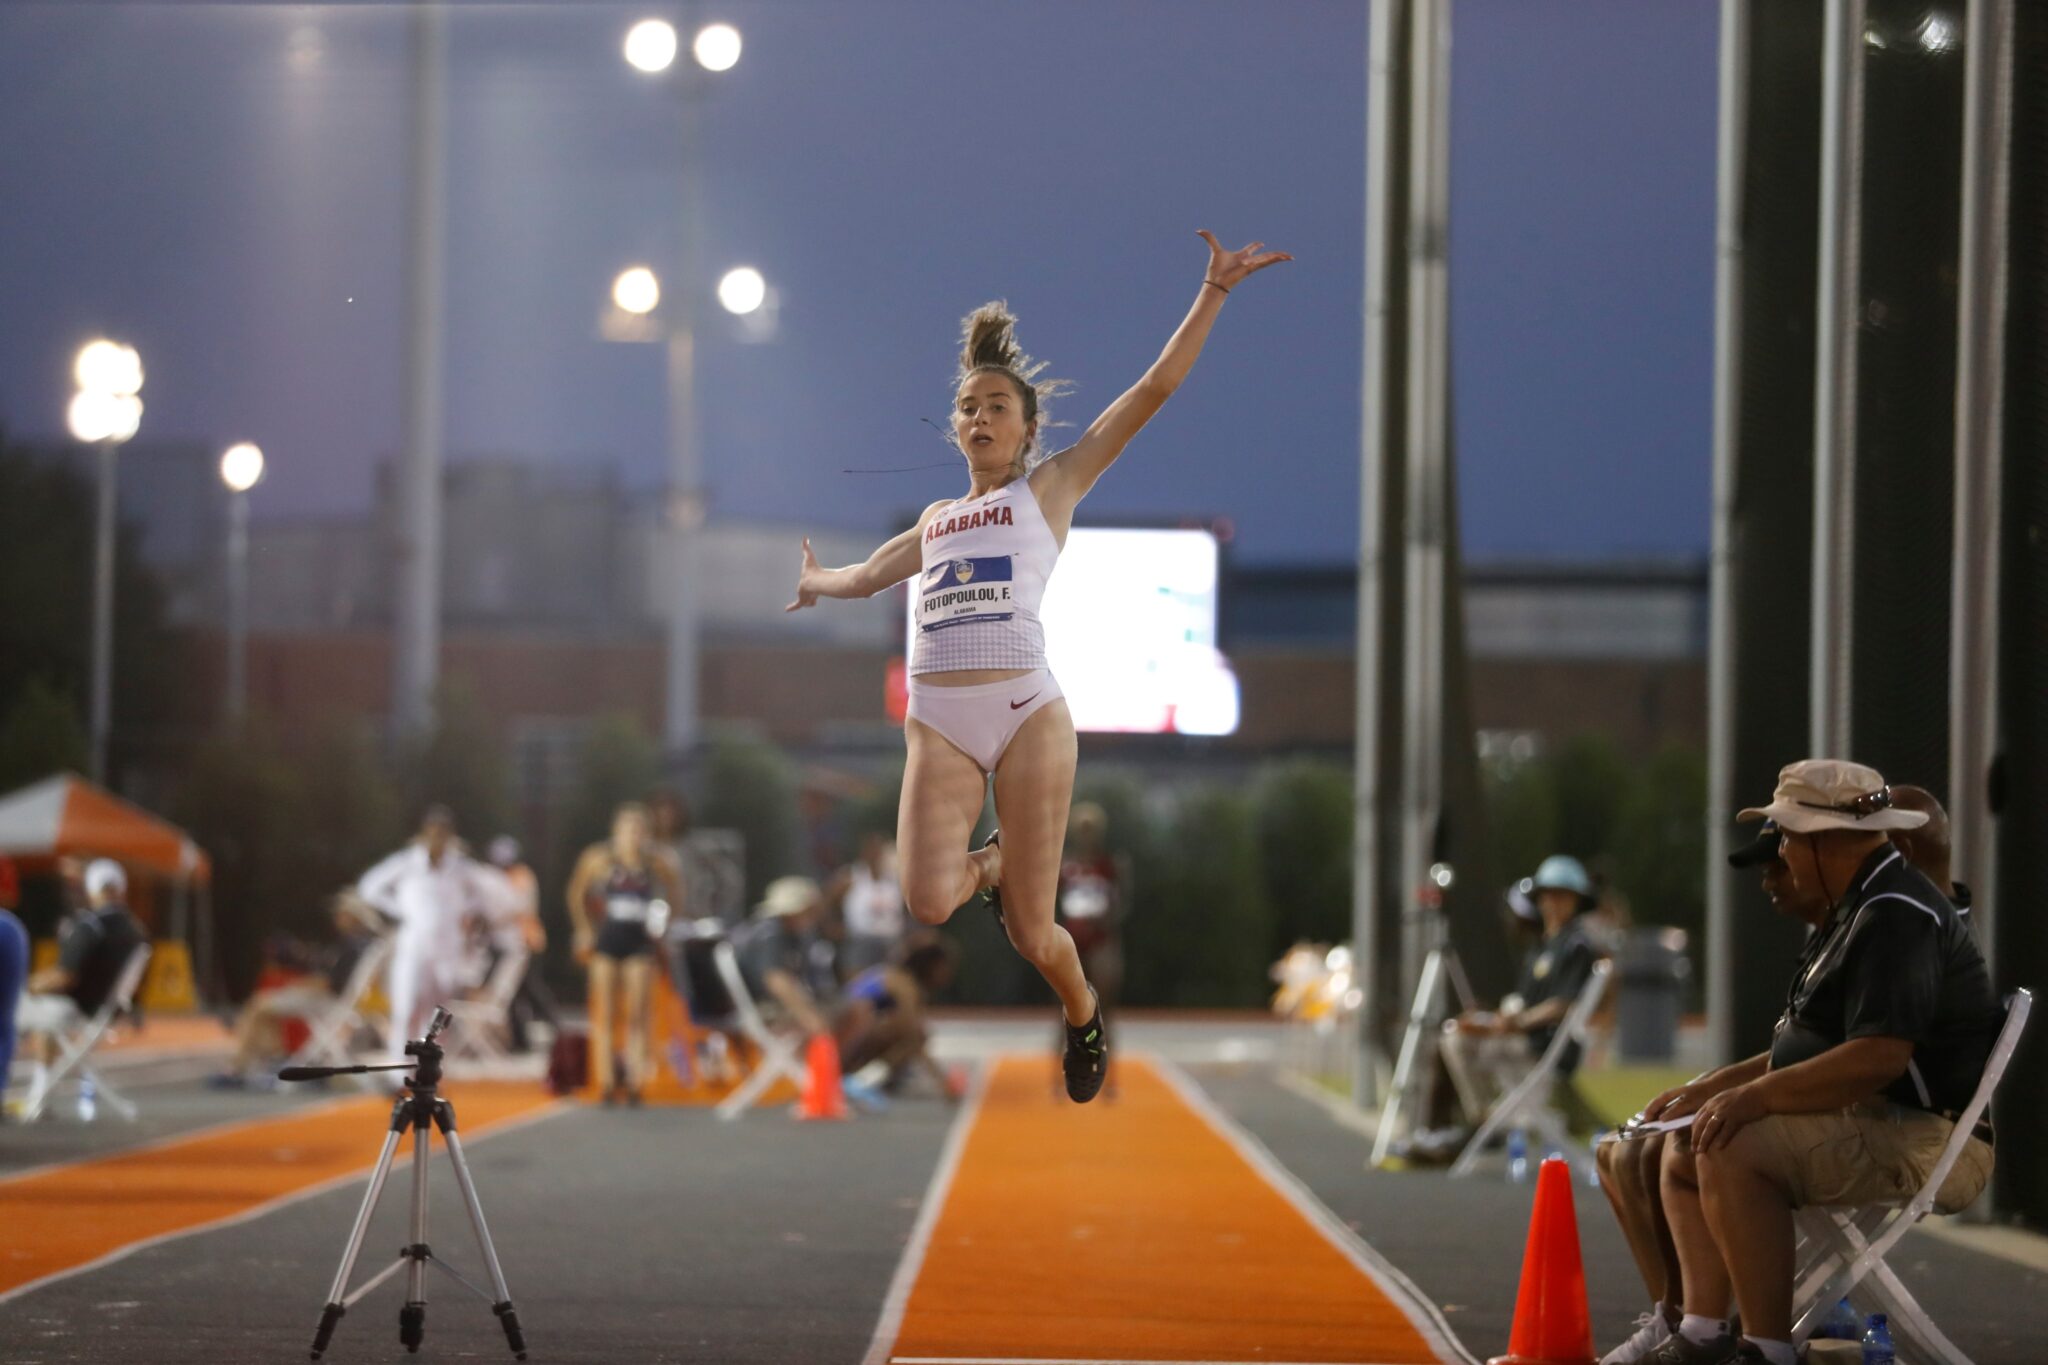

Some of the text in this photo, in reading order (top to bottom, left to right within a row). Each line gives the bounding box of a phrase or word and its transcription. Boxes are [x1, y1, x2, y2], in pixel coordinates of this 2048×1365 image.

[925, 506, 1013, 544] ALABAMA
[924, 587, 1010, 612] FOTOPOULOU, F.
[954, 606, 976, 614] ALABAMA
